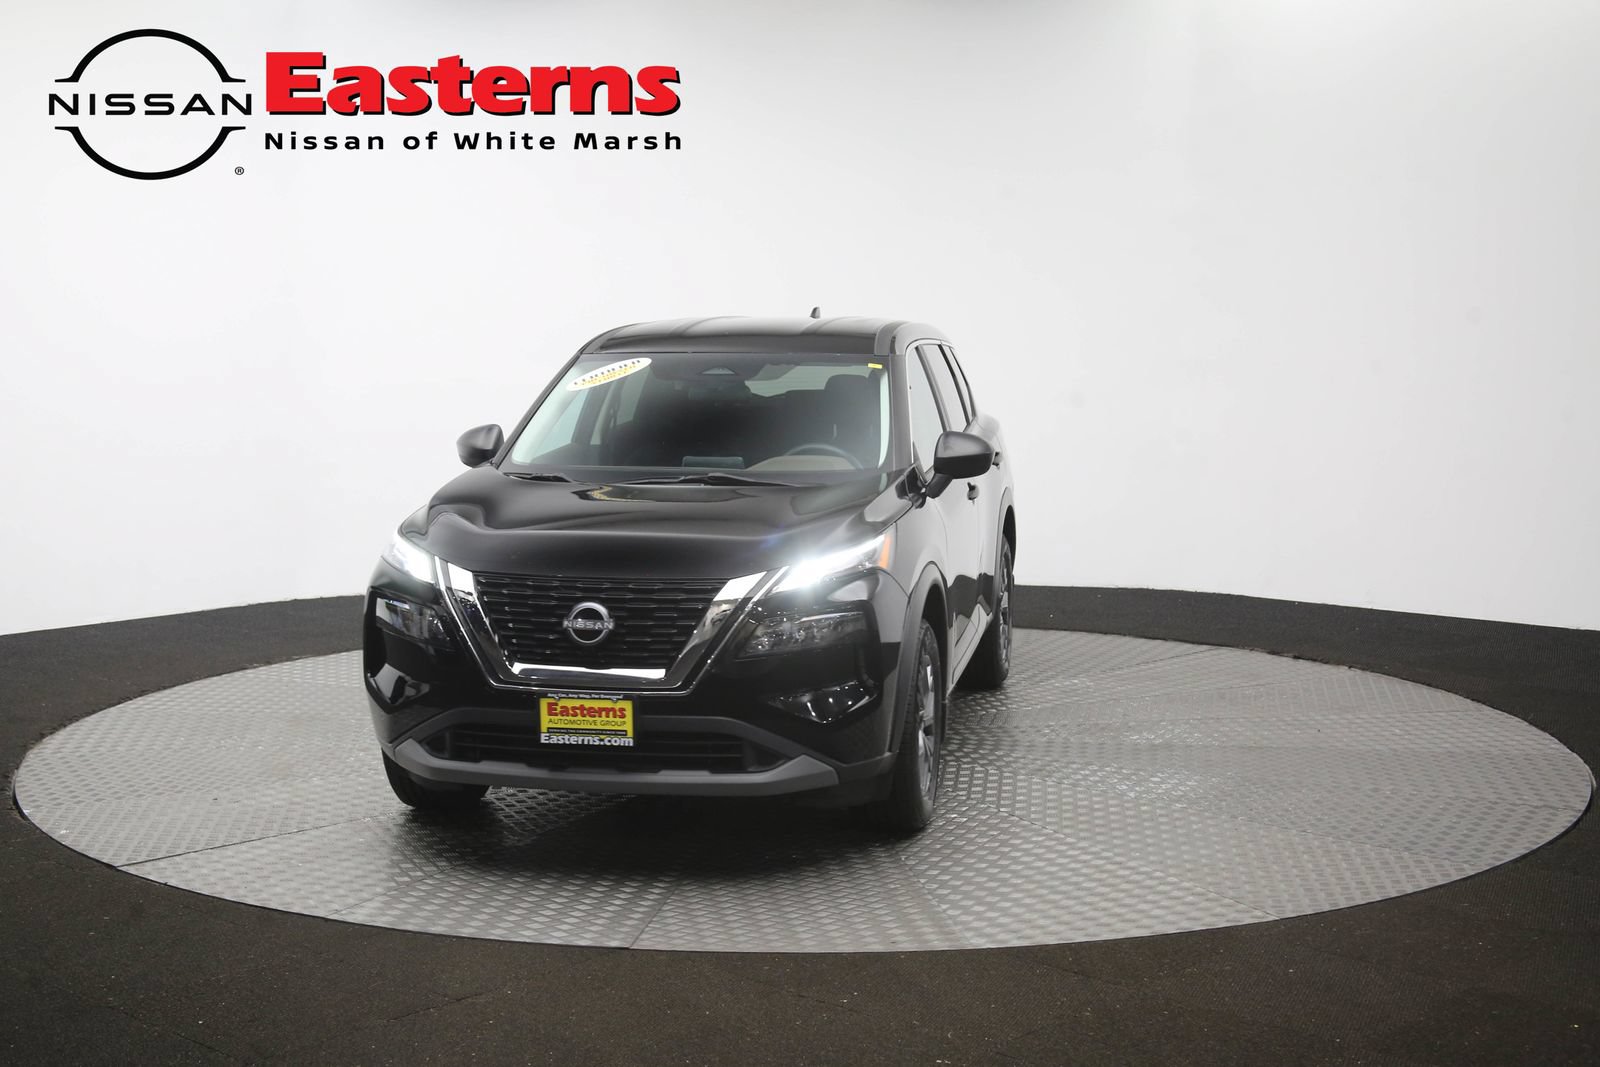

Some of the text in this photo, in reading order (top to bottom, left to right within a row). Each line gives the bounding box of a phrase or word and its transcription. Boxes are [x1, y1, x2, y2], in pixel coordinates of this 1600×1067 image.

[563, 619, 614, 630] NISSAN
[547, 702, 626, 719] Easterns
[548, 718, 626, 727] AUTOMOTIVE GROUP
[540, 733, 634, 746] Easterns.com
